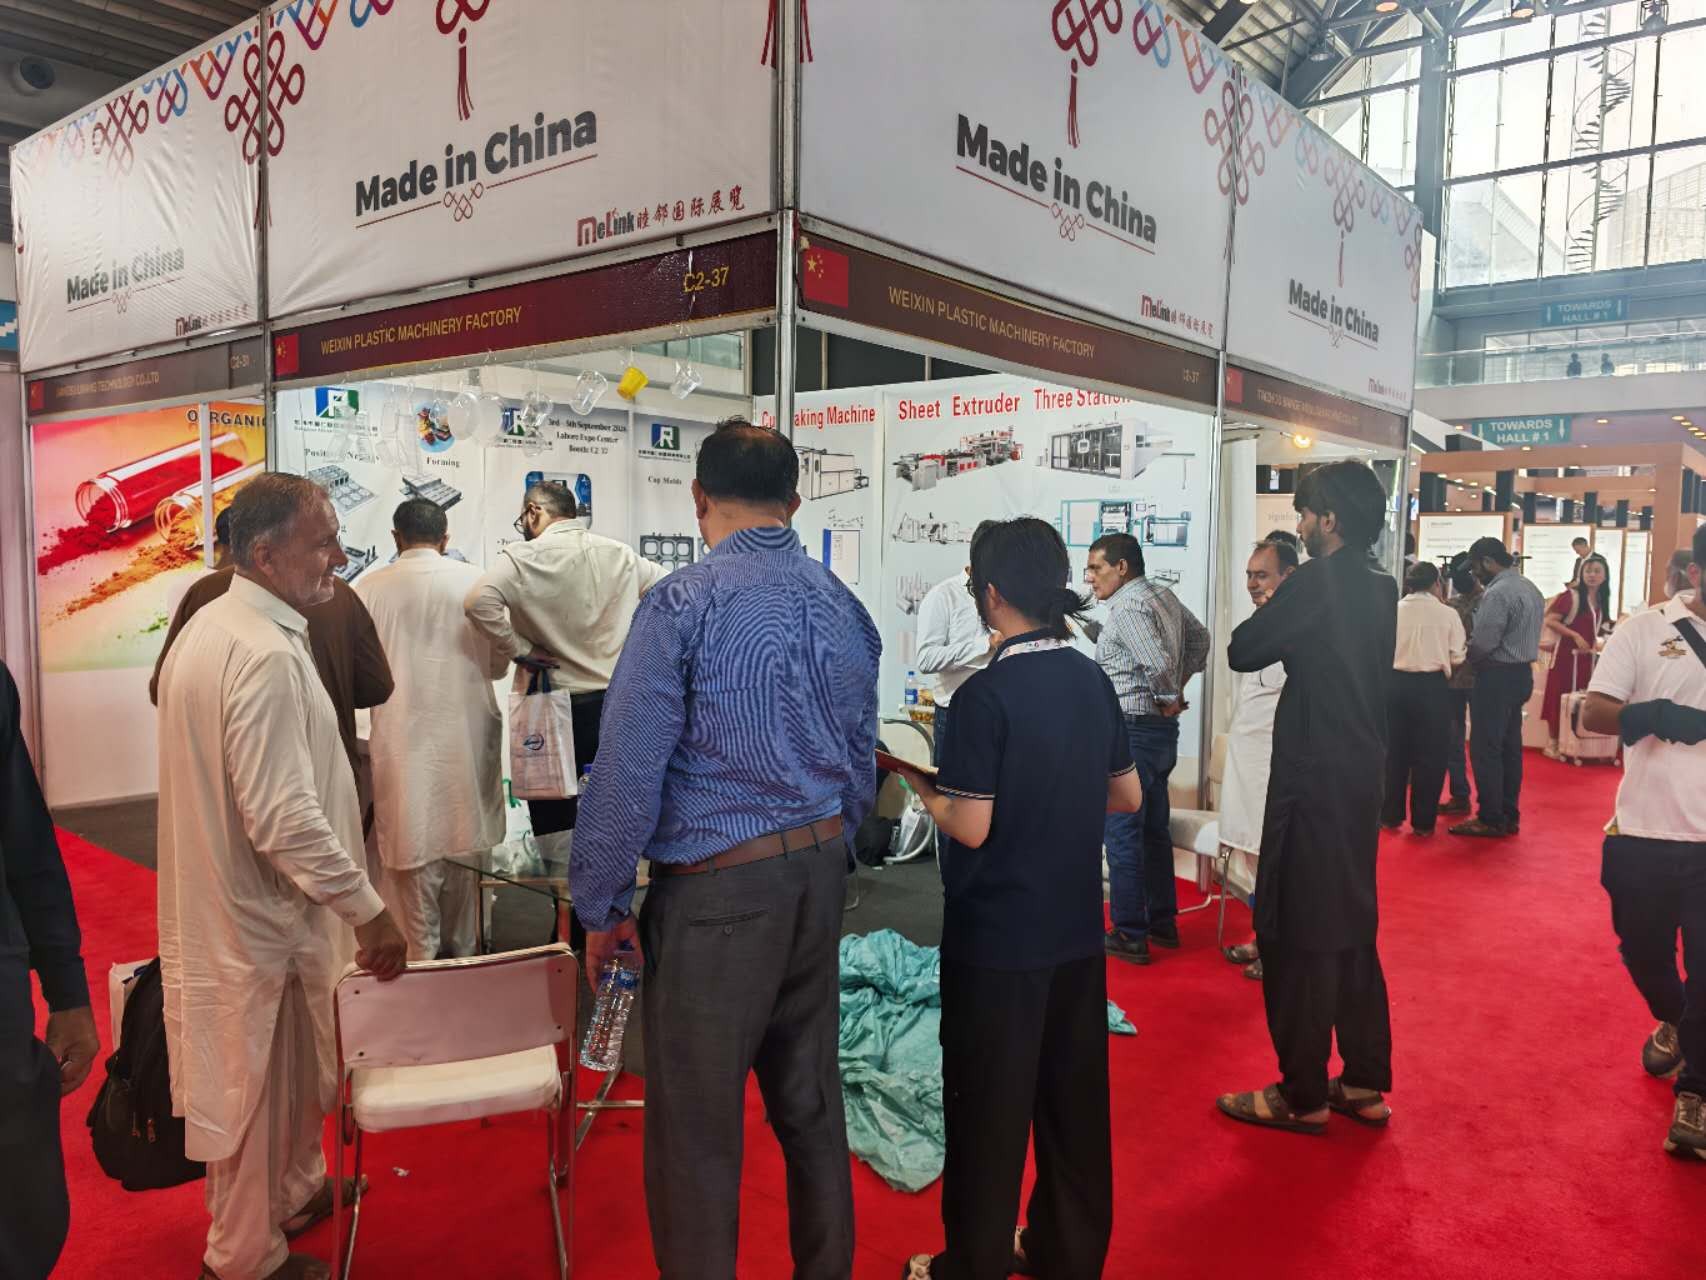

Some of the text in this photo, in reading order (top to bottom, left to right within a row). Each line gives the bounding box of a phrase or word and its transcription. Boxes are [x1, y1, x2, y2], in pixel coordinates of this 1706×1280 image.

[355, 110, 597, 217] Made in China
[956, 113, 1156, 244] Made in China
[67, 246, 184, 304] Made in China
[683, 265, 730, 293] C2-37
[1288, 277, 1379, 342] Made in China
[1557, 300, 1611, 312] TOWARDS
[320, 306, 523, 356] WEIXIN PLASTIC MACHINERY FACTORY
[888, 285, 1096, 359] WEIXIN PLASTIC MACHINERY FACTORY
[899, 391, 1021, 420] Sheet Extruder
[1034, 388, 1073, 410] Three
[794, 408, 824, 430] aking
[826, 404, 876, 425] Machine
[1489, 419, 1553, 431] TOWARDS
[1496, 432, 1530, 443] HALL
[1532, 431, 1540, 443] #
